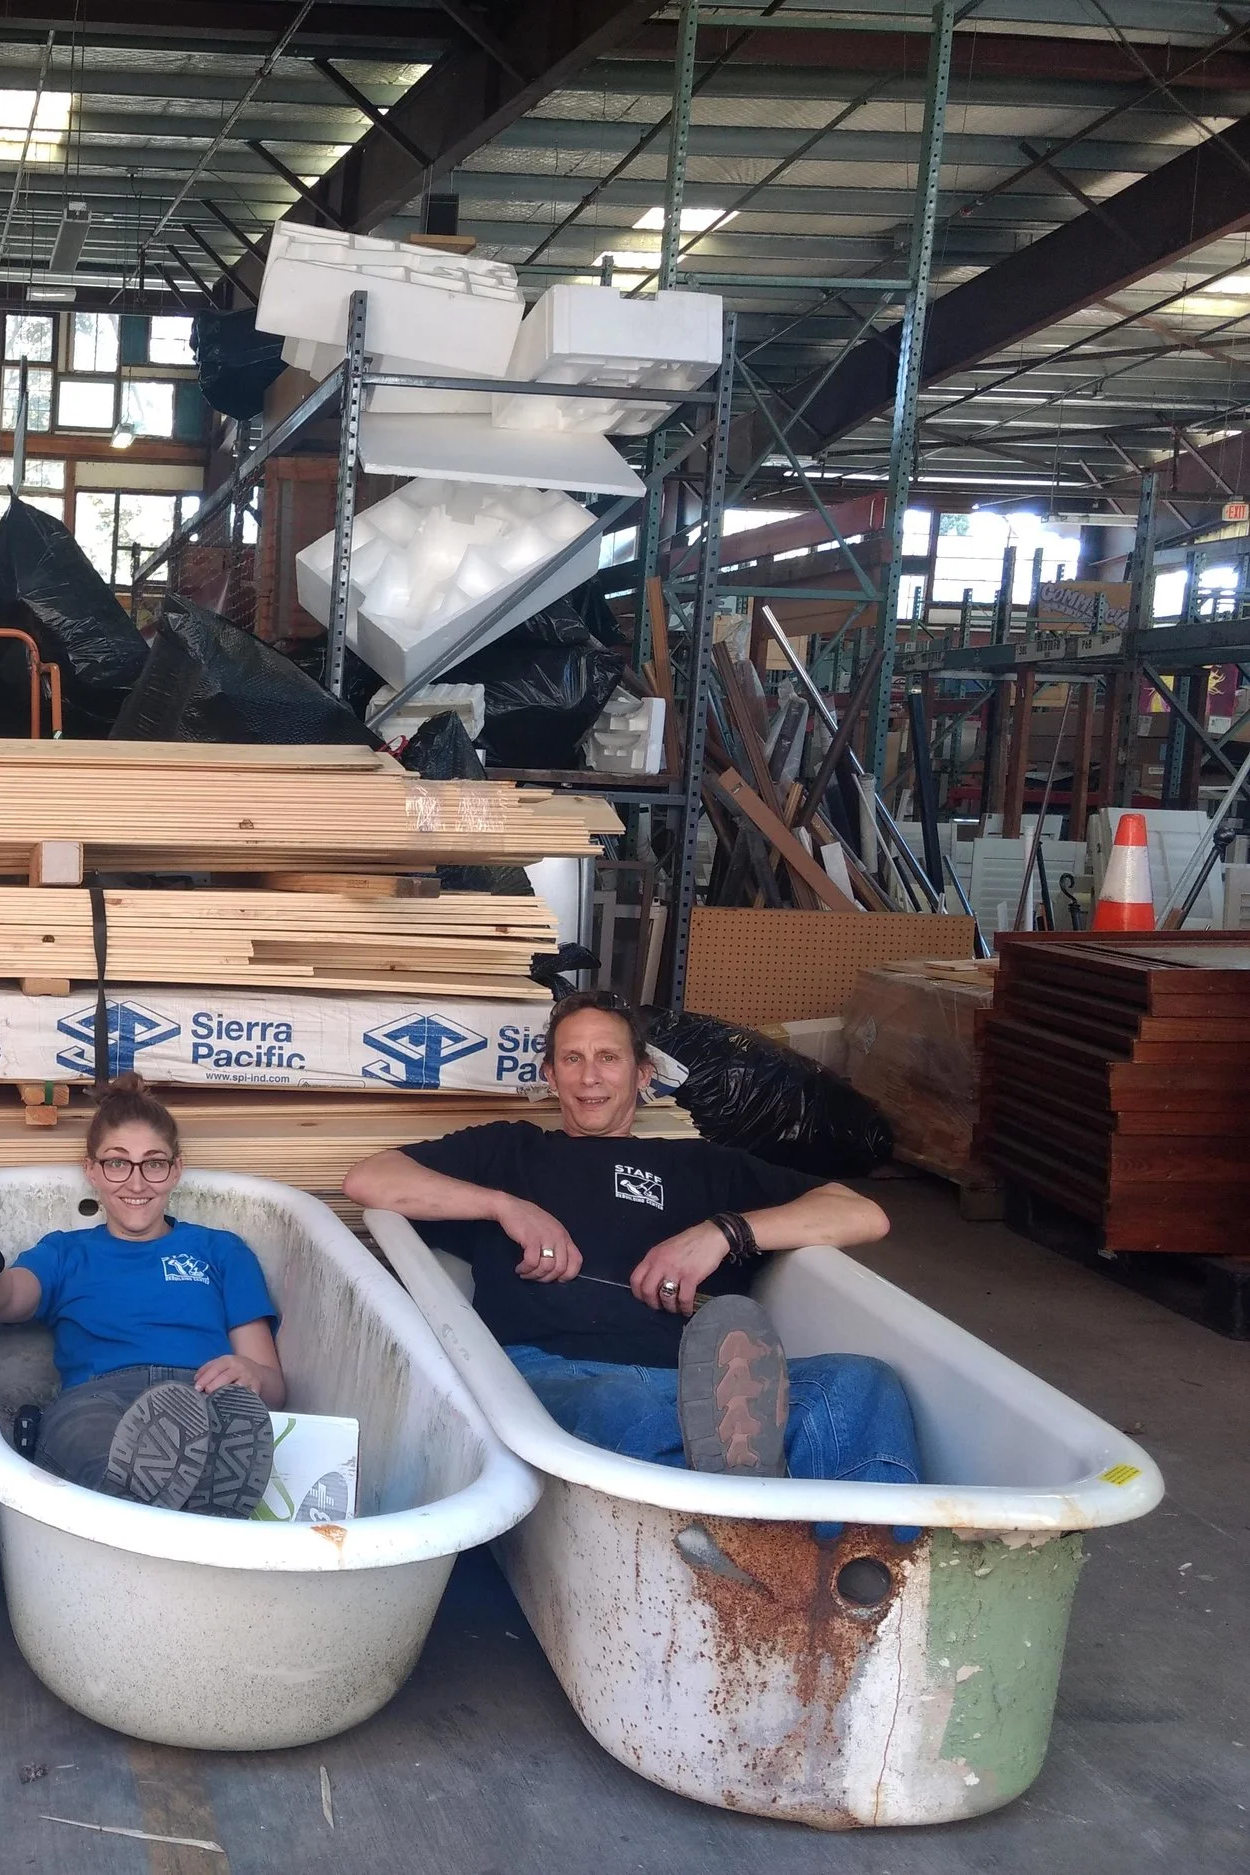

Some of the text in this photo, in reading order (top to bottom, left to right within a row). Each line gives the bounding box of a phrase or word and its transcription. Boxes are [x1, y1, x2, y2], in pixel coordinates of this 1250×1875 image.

[1229, 505, 1246, 519] EXIT
[191, 1012, 292, 1043] Sierra
[192, 1043, 305, 1070] Pacific
[206, 1073, 290, 1083] www.spi-ind.com
[615, 1164, 662, 1183] STAFF
